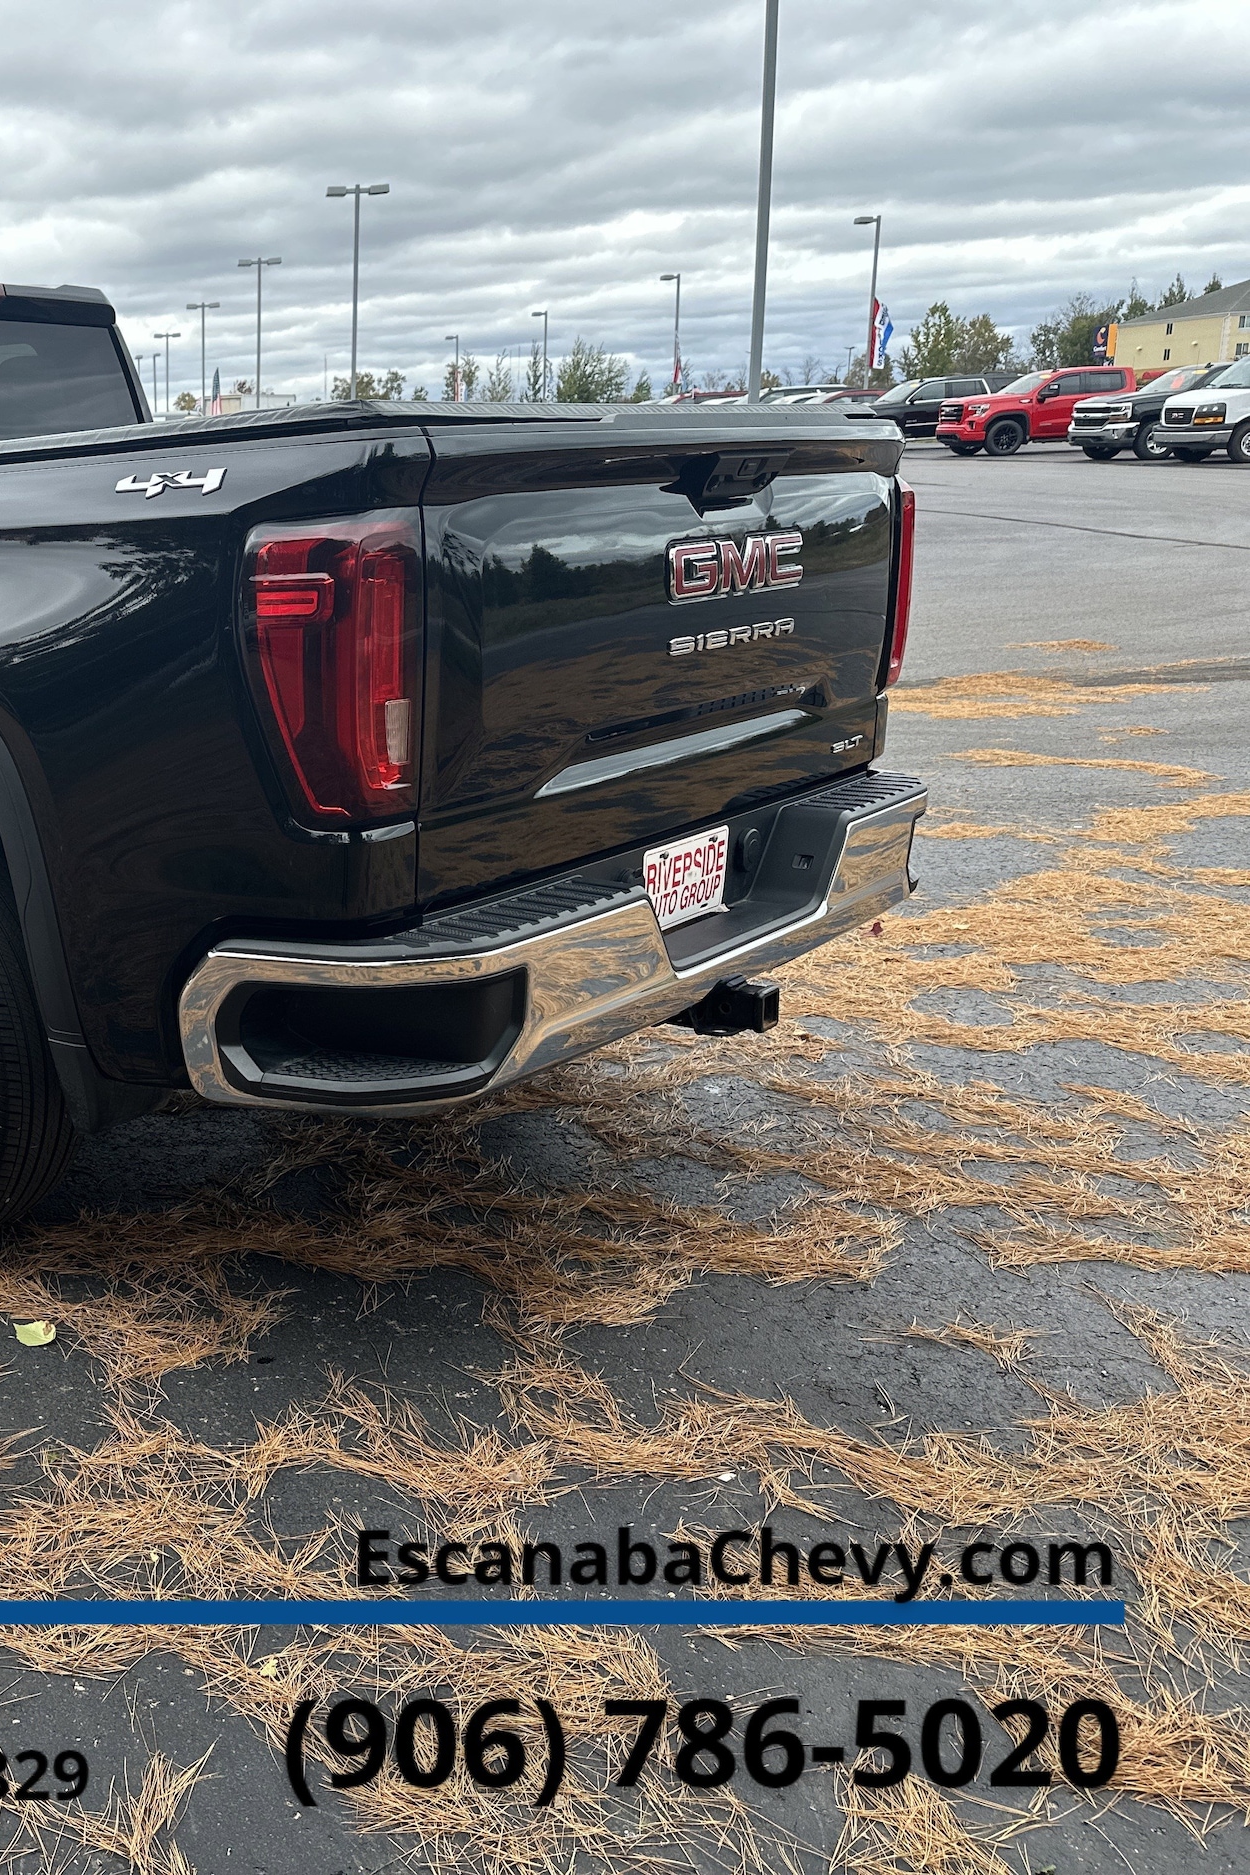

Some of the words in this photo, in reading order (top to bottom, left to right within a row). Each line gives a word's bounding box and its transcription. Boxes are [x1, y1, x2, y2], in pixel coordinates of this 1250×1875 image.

[665, 530, 804, 605] GMC
[667, 617, 795, 657] SIERRA
[830, 734, 864, 754] SLT
[679, 873, 722, 911] GROUP
